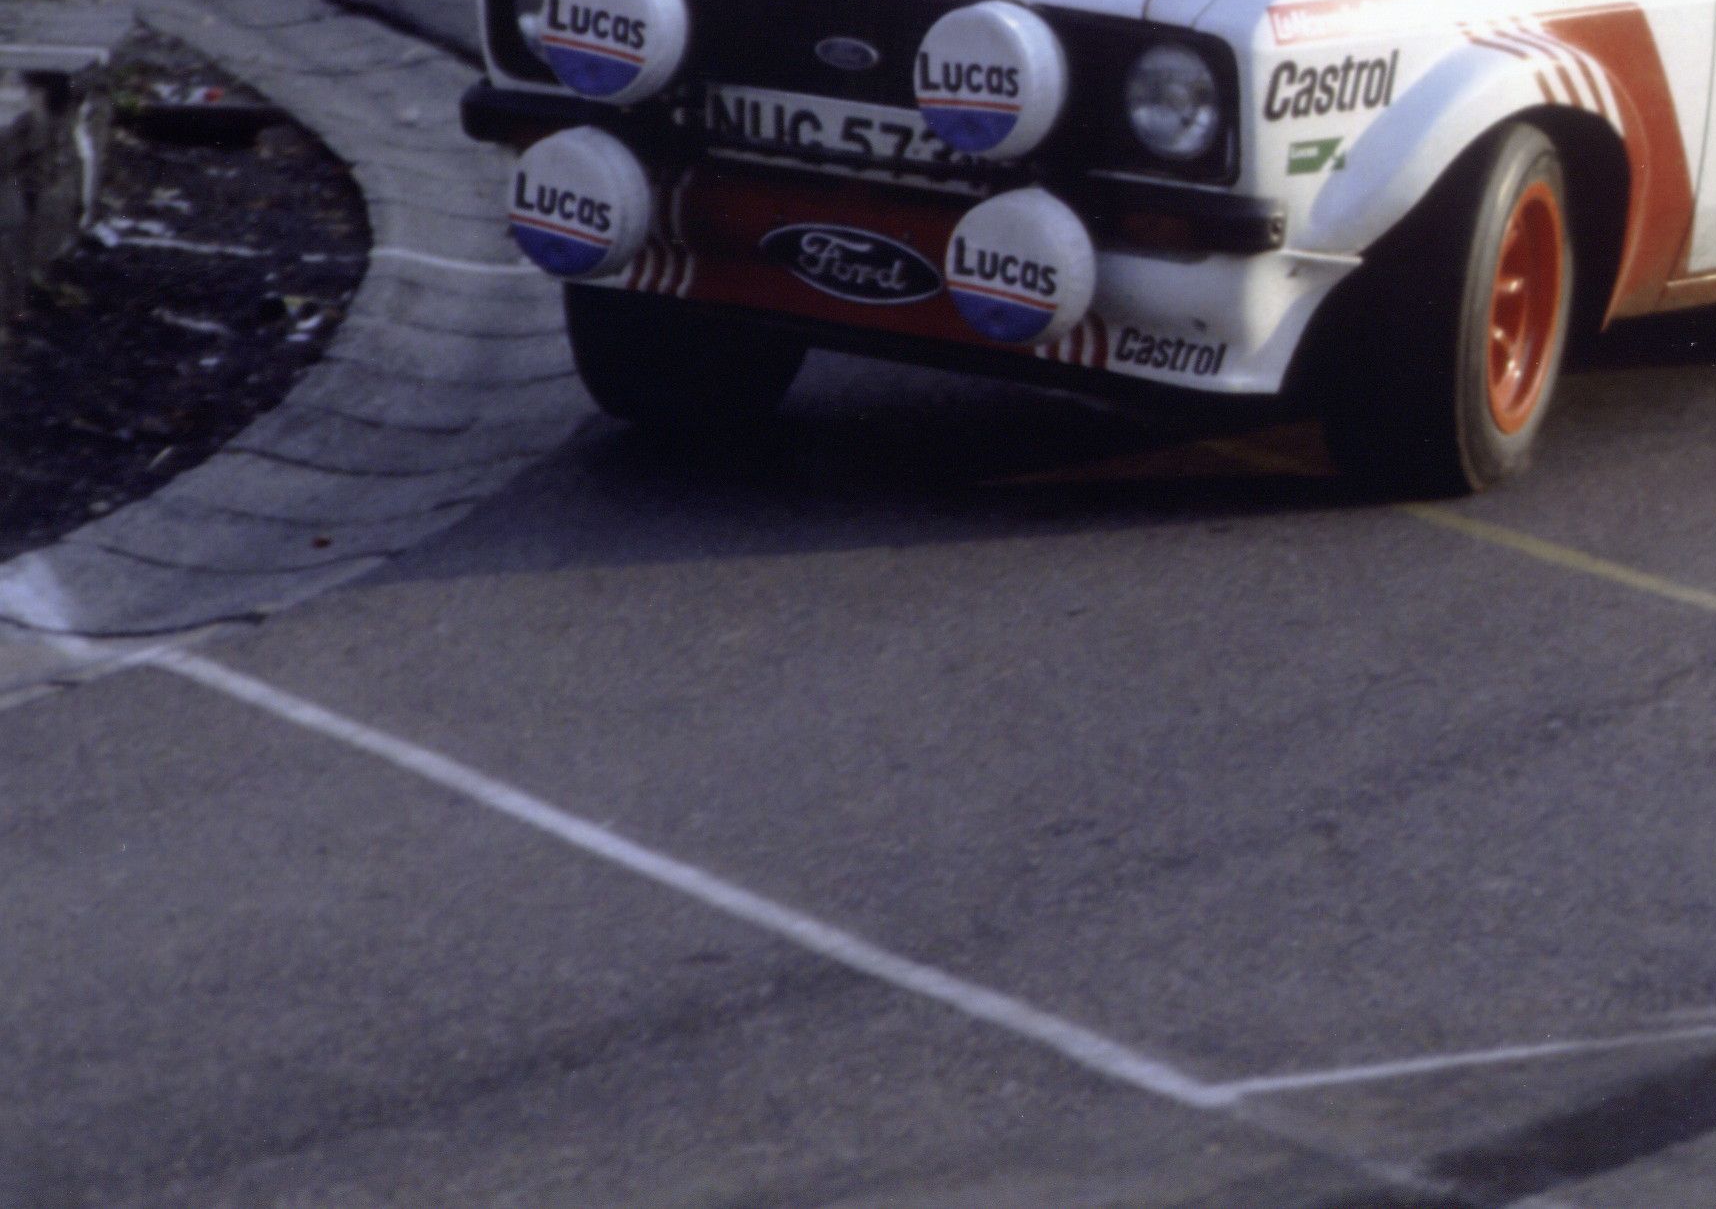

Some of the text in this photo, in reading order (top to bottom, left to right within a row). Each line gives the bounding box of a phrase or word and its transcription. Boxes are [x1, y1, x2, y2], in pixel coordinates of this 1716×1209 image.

[918, 51, 1022, 99] Lucas
[1263, 48, 1400, 123] Castrol
[706, 90, 824, 152] NUC
[513, 172, 613, 231] Lucas
[800, 231, 908, 290] Ford
[953, 236, 1060, 297] Lucas
[1114, 326, 1228, 376] Castrol
